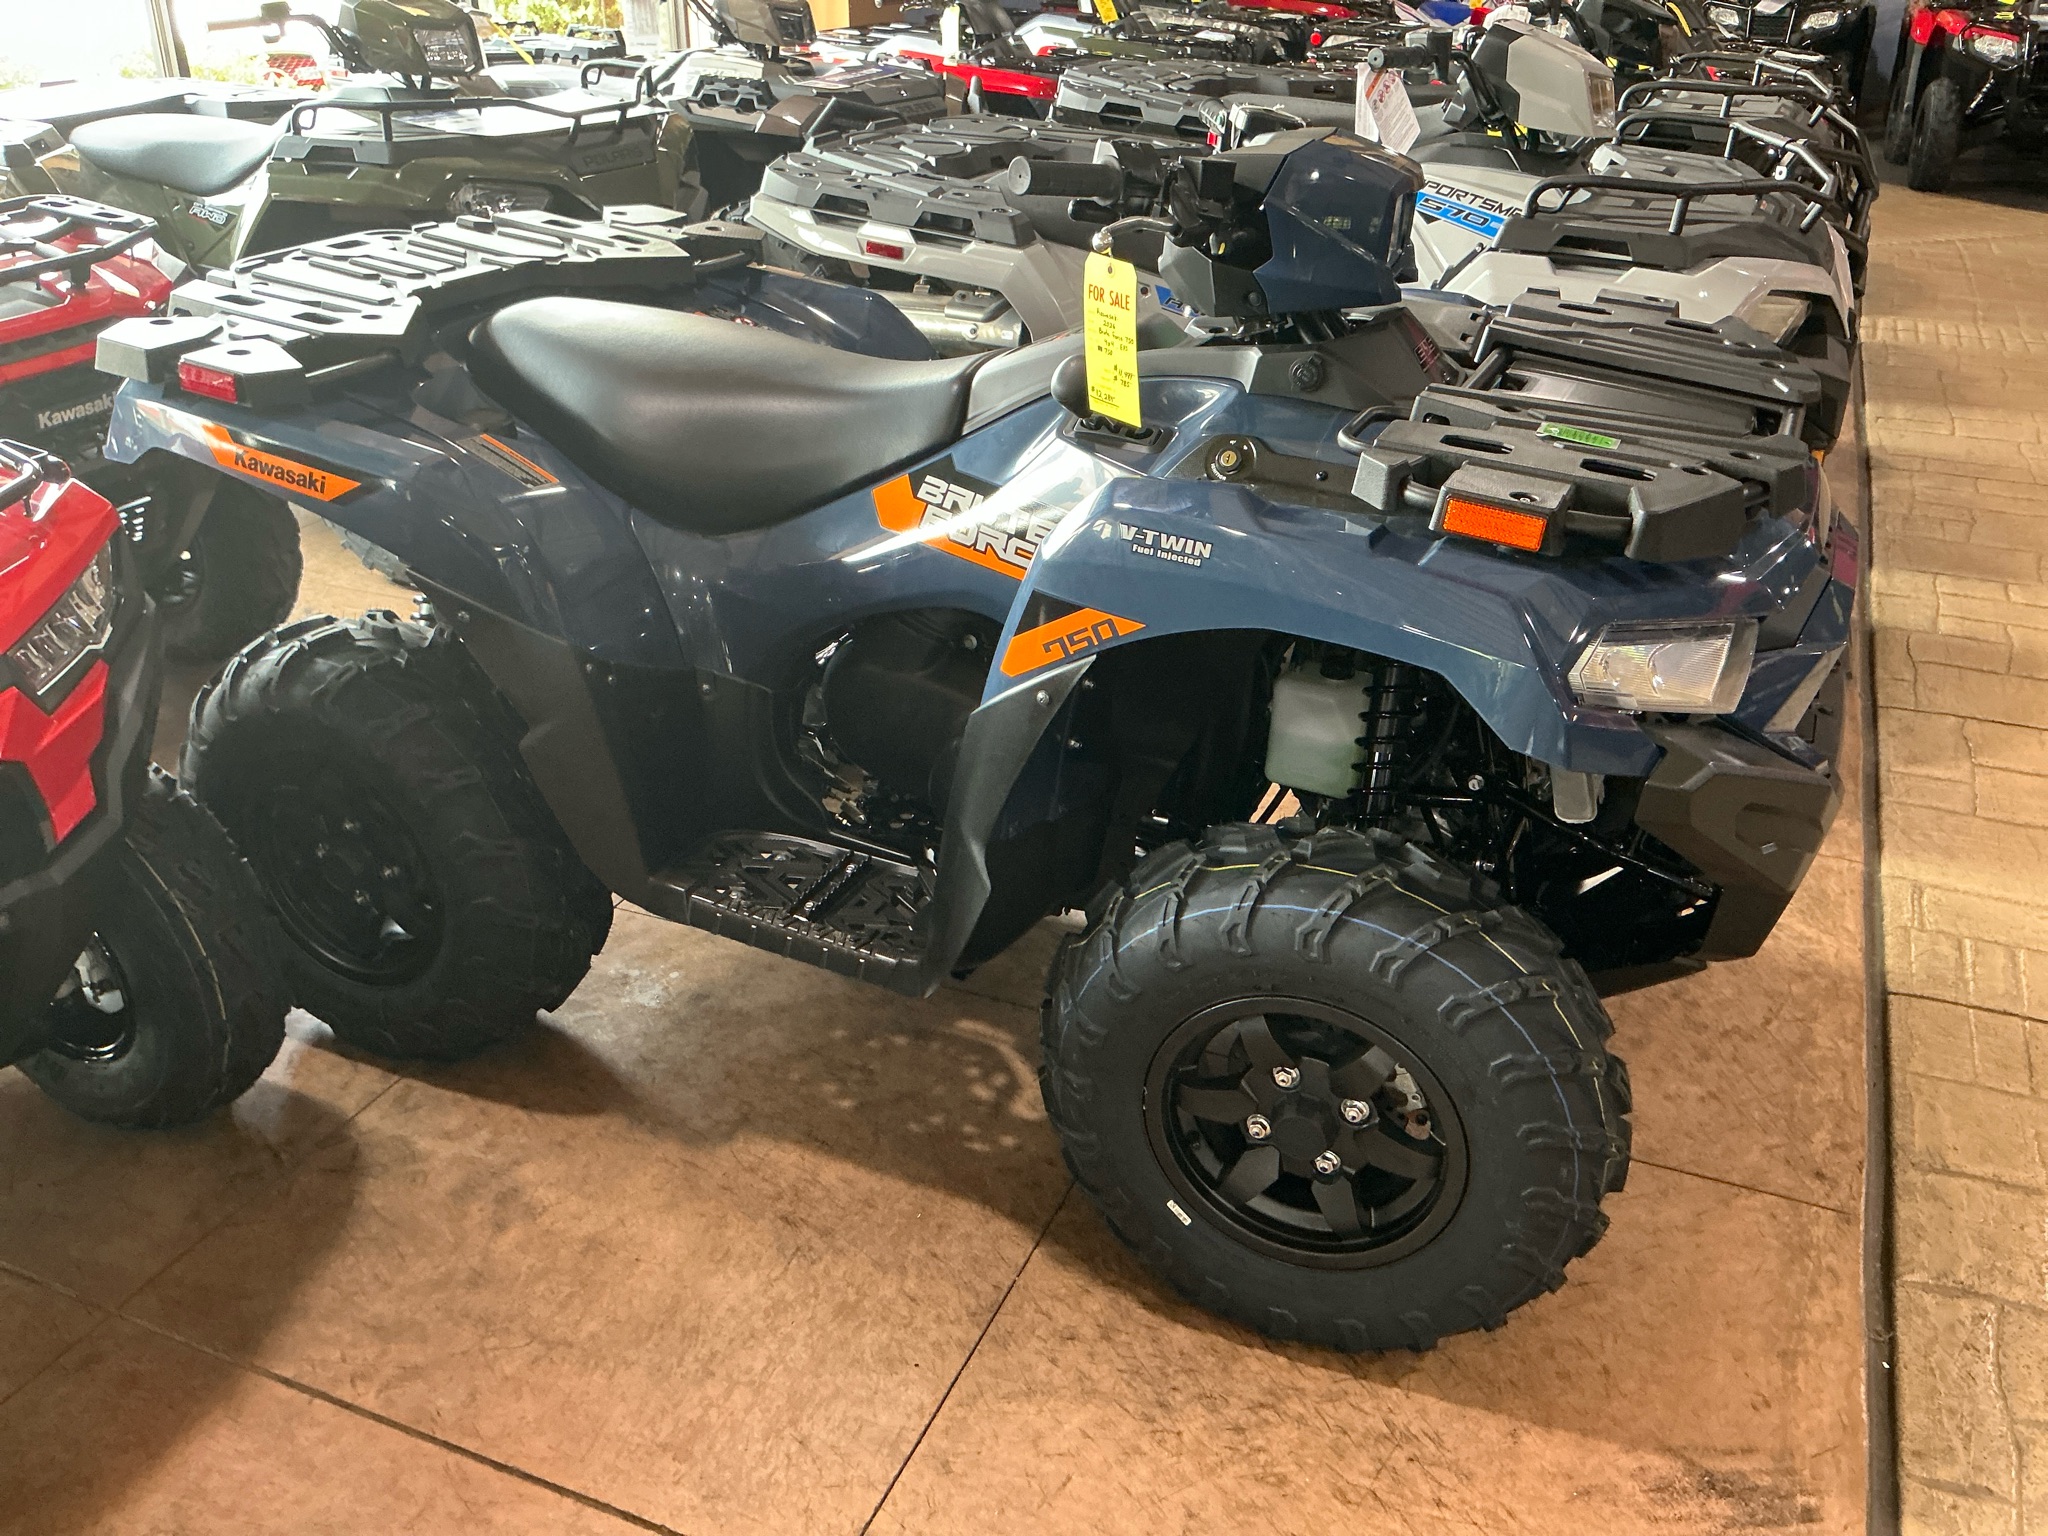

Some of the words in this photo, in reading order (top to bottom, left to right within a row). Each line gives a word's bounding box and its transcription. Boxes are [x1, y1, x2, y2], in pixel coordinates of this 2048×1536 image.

[189, 205, 227, 225] AWD
[1419, 197, 1490, 227] 570
[1423, 181, 1523, 217] PORTSM
[1088, 284, 1105, 303] FOR
[1109, 290, 1130, 311] SALE
[234, 450, 326, 494] Kawasaki
[917, 475, 1058, 544] BRTE
[918, 505, 1041, 569] FORC
[1119, 522, 1212, 559] V-TWIN
[1131, 543, 1154, 556] Fuel
[1157, 549, 1202, 567] Injected
[1042, 618, 1121, 659] 750
